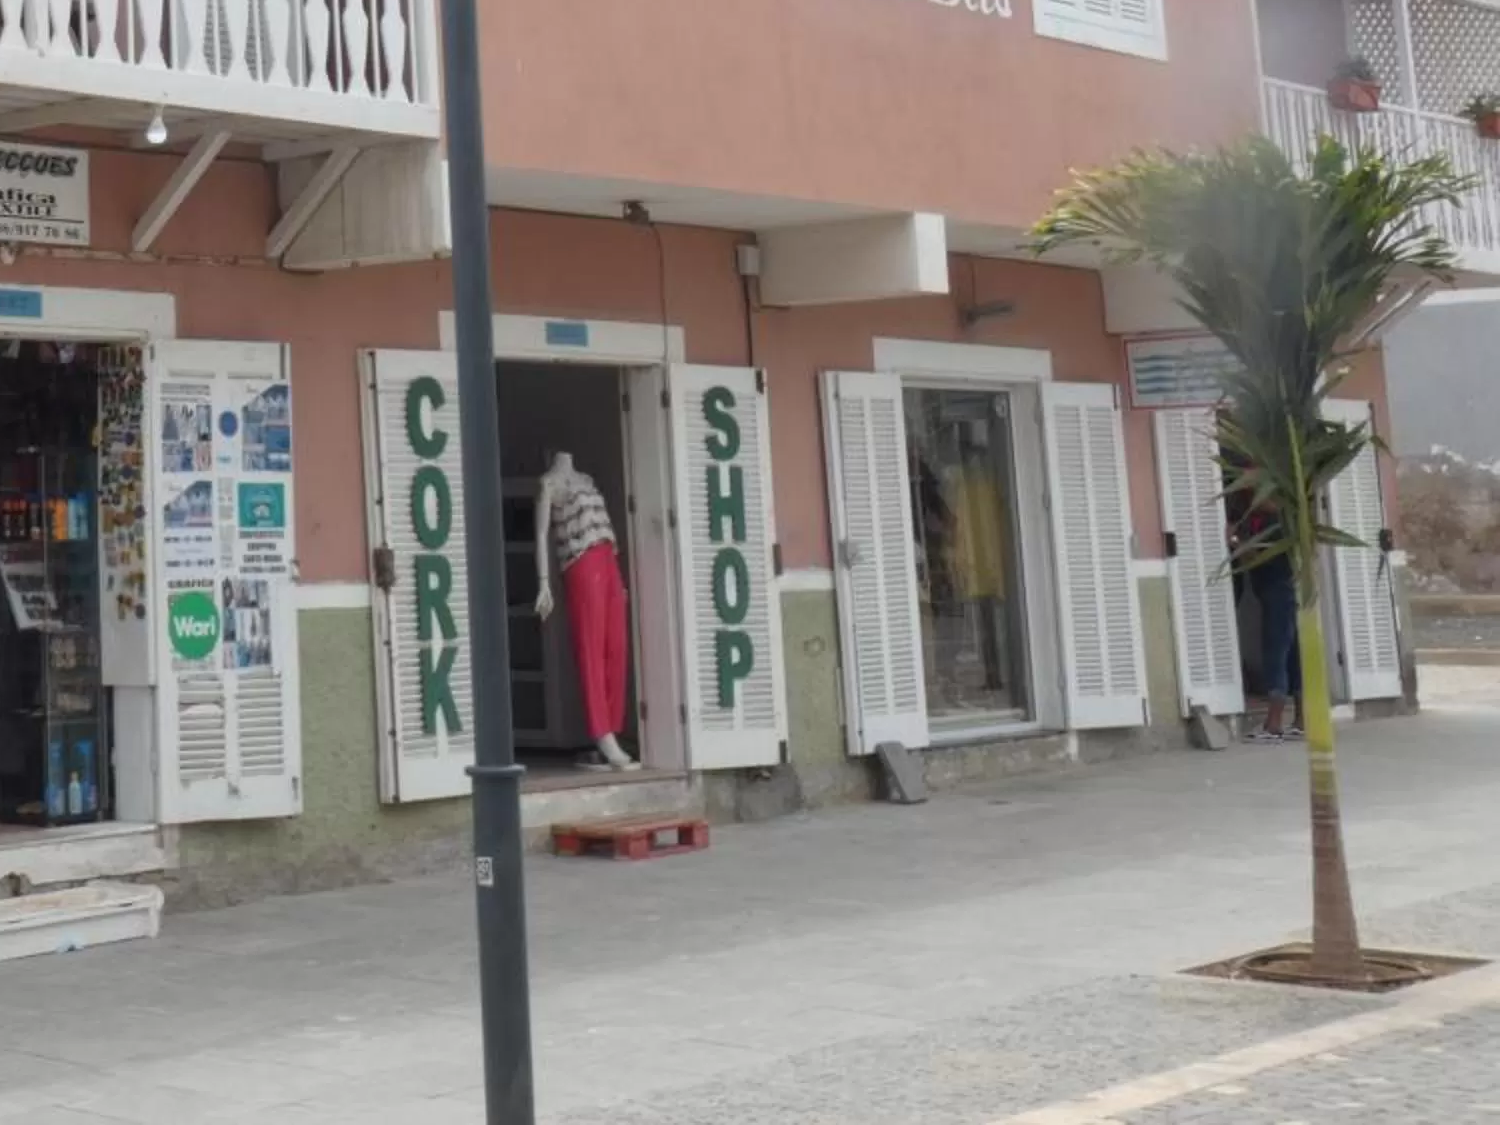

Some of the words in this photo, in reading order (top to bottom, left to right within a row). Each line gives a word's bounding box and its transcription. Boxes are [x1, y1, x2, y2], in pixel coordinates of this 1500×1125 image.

[173, 615, 216, 638] Wari
[405, 376, 462, 735] CORK
[702, 385, 755, 709] SHOP
